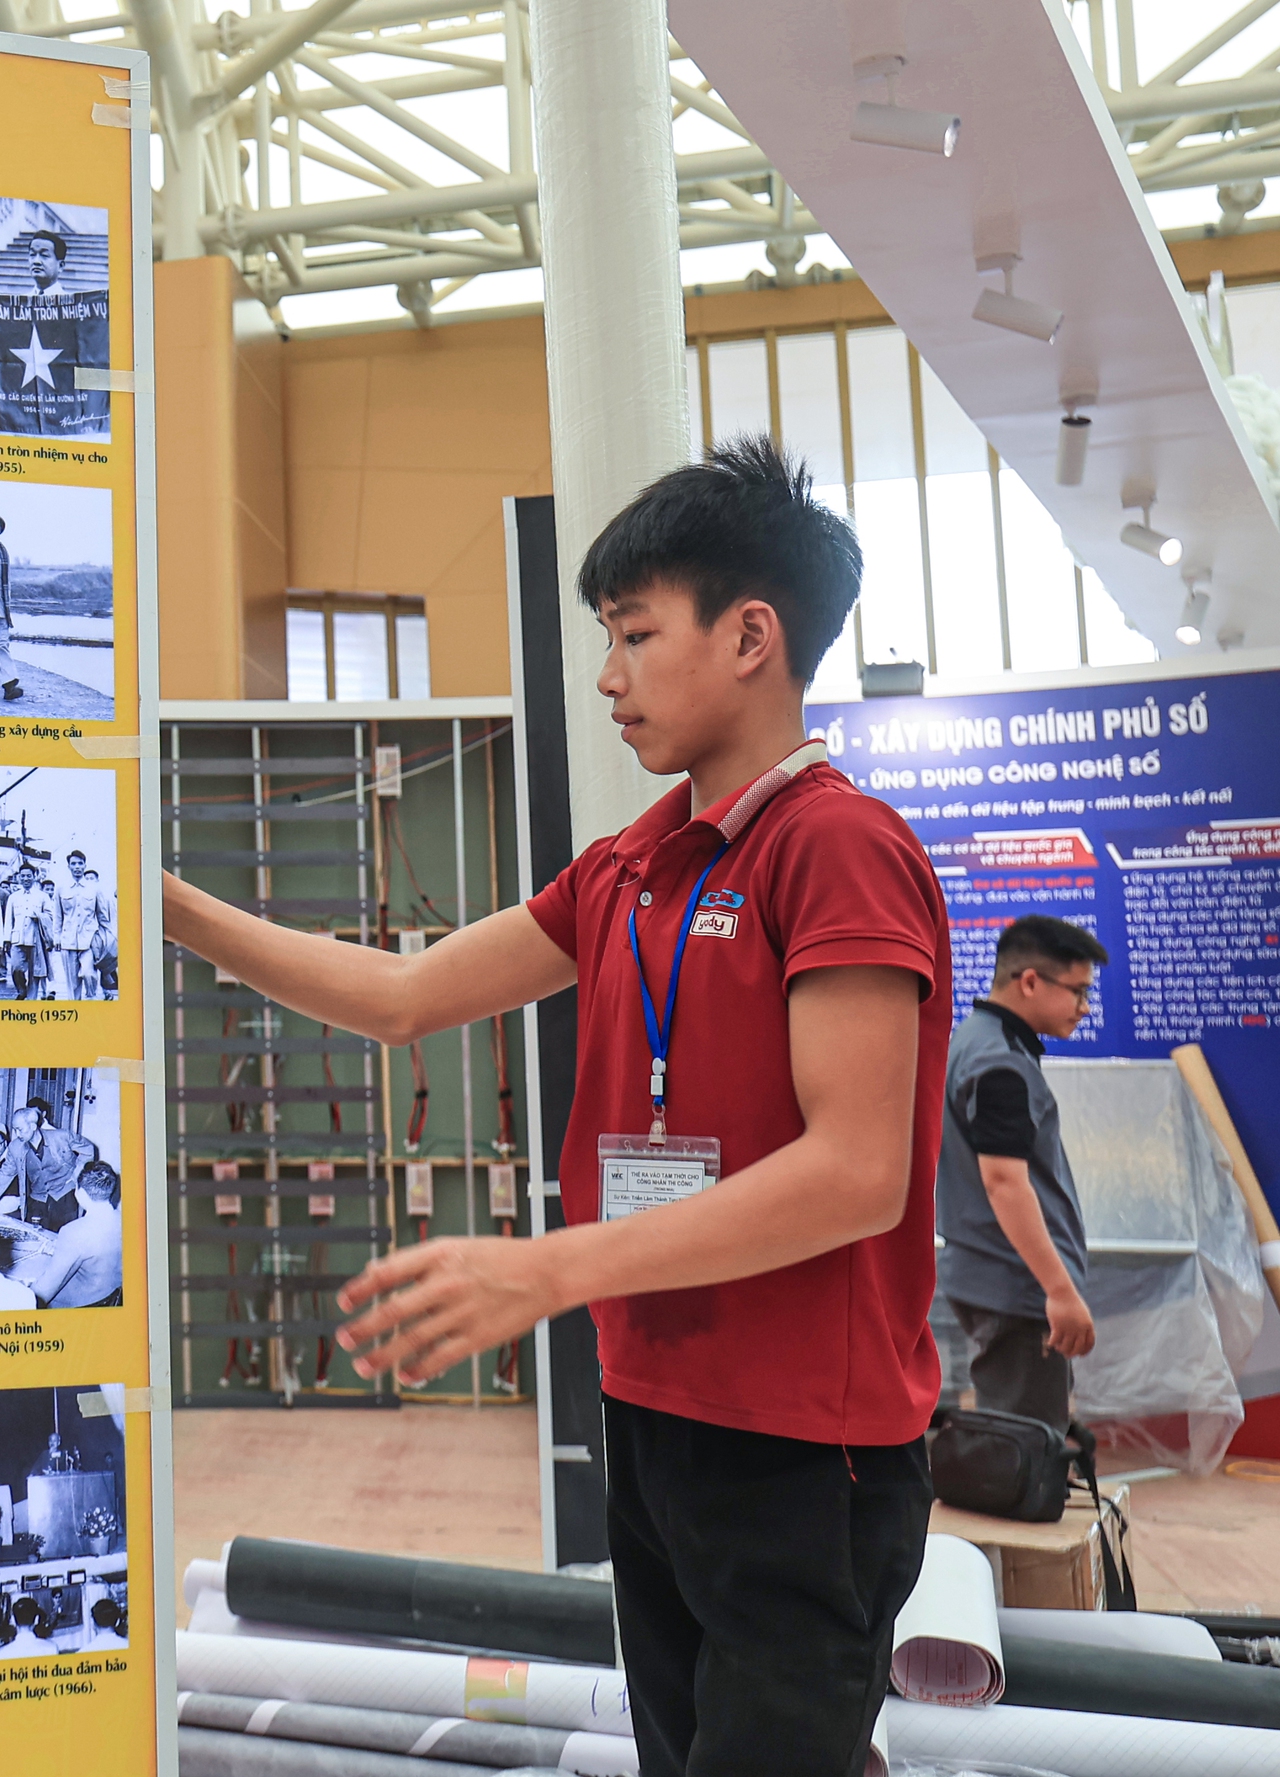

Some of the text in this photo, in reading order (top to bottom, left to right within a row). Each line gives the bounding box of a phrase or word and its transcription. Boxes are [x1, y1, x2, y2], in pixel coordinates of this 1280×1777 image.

[62, 302, 91, 321] NHIỆM
[92, 302, 107, 319] VỤ
[6, 445, 30, 458] tròn
[33, 446, 69, 463] nhiệm
[71, 453, 85, 465] vụ
[87, 451, 108, 464] cho
[869, 717, 922, 755] XÂY
[927, 715, 1004, 756] DỰNG
[1009, 706, 1096, 747] CHÍNH
[1102, 696, 1161, 741] PHỦ
[1168, 691, 1209, 736] SỐ
[870, 767, 918, 791] ỨNG
[921, 765, 984, 791] DỤNG
[988, 760, 1058, 785] CÔNG
[1062, 753, 1124, 781] NGHỆ
[1128, 748, 1161, 776] SỐ
[0, 1008, 38, 1025] Phòng
[40, 1009, 79, 1023] (1957)
